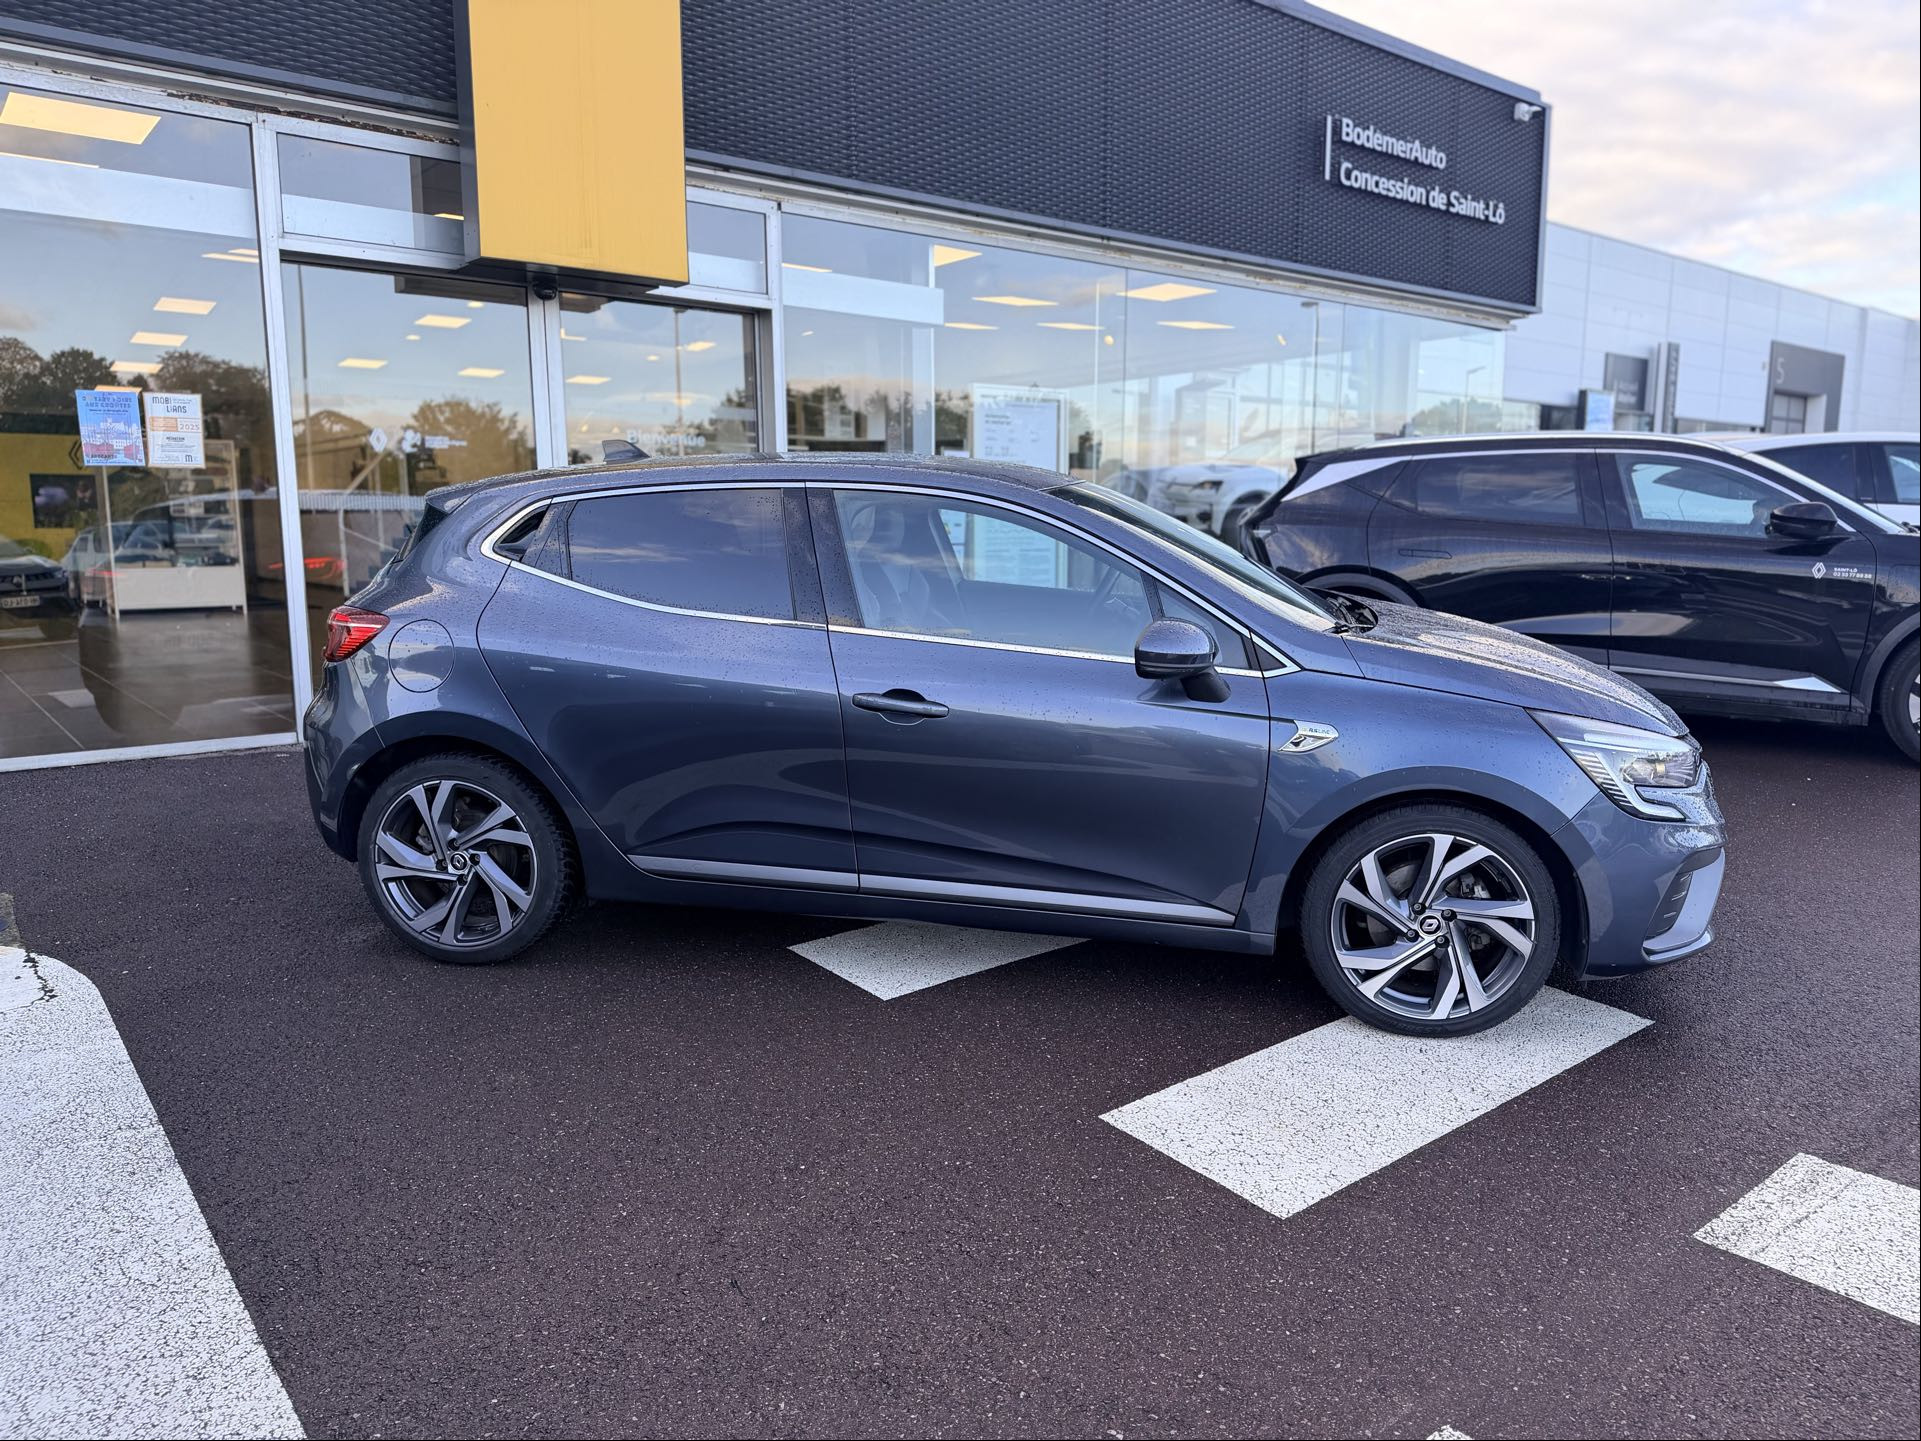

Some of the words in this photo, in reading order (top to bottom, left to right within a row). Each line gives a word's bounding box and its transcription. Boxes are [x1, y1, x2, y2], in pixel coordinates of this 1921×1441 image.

[1341, 117, 1447, 170] BodemerAuto
[1339, 162, 1427, 205] Concession
[1428, 186, 1448, 210] de
[1449, 191, 1506, 224] Saint-Lô
[152, 396, 172, 405] MOBI
